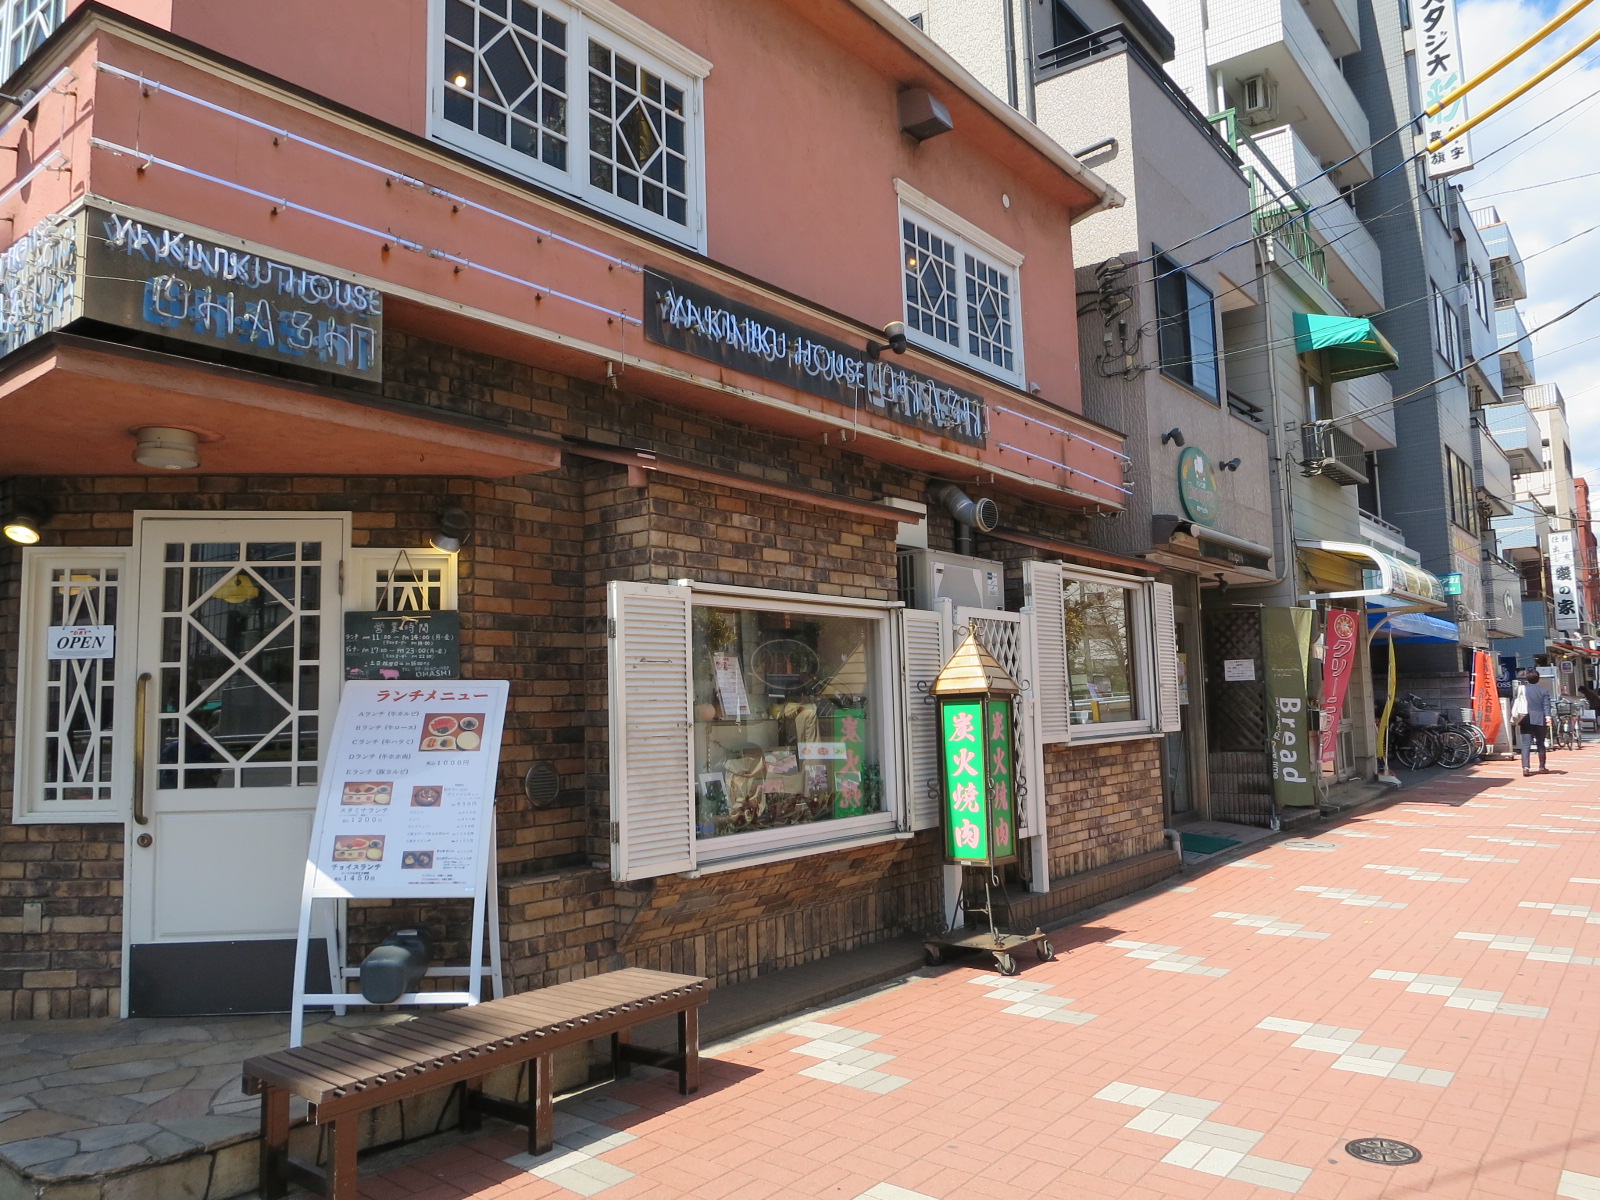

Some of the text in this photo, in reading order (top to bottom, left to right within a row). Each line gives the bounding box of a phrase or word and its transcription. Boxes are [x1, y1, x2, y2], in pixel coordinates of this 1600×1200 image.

[279, 267, 382, 317] HOUSE
[655, 289, 786, 362] YAKINIKU
[788, 336, 865, 389] HOUSE
[57, 636, 106, 649] OPEN
[373, 621, 429, 634] 営業時間
[416, 670, 451, 678] OHASHI
[376, 689, 489, 703] ランチメニュー
[1279, 697, 1307, 783] Bread
[948, 711, 980, 849] 炭火焼肉
[990, 710, 1009, 848] 炭火焼肉
[331, 863, 382, 871] チョイスランチ
